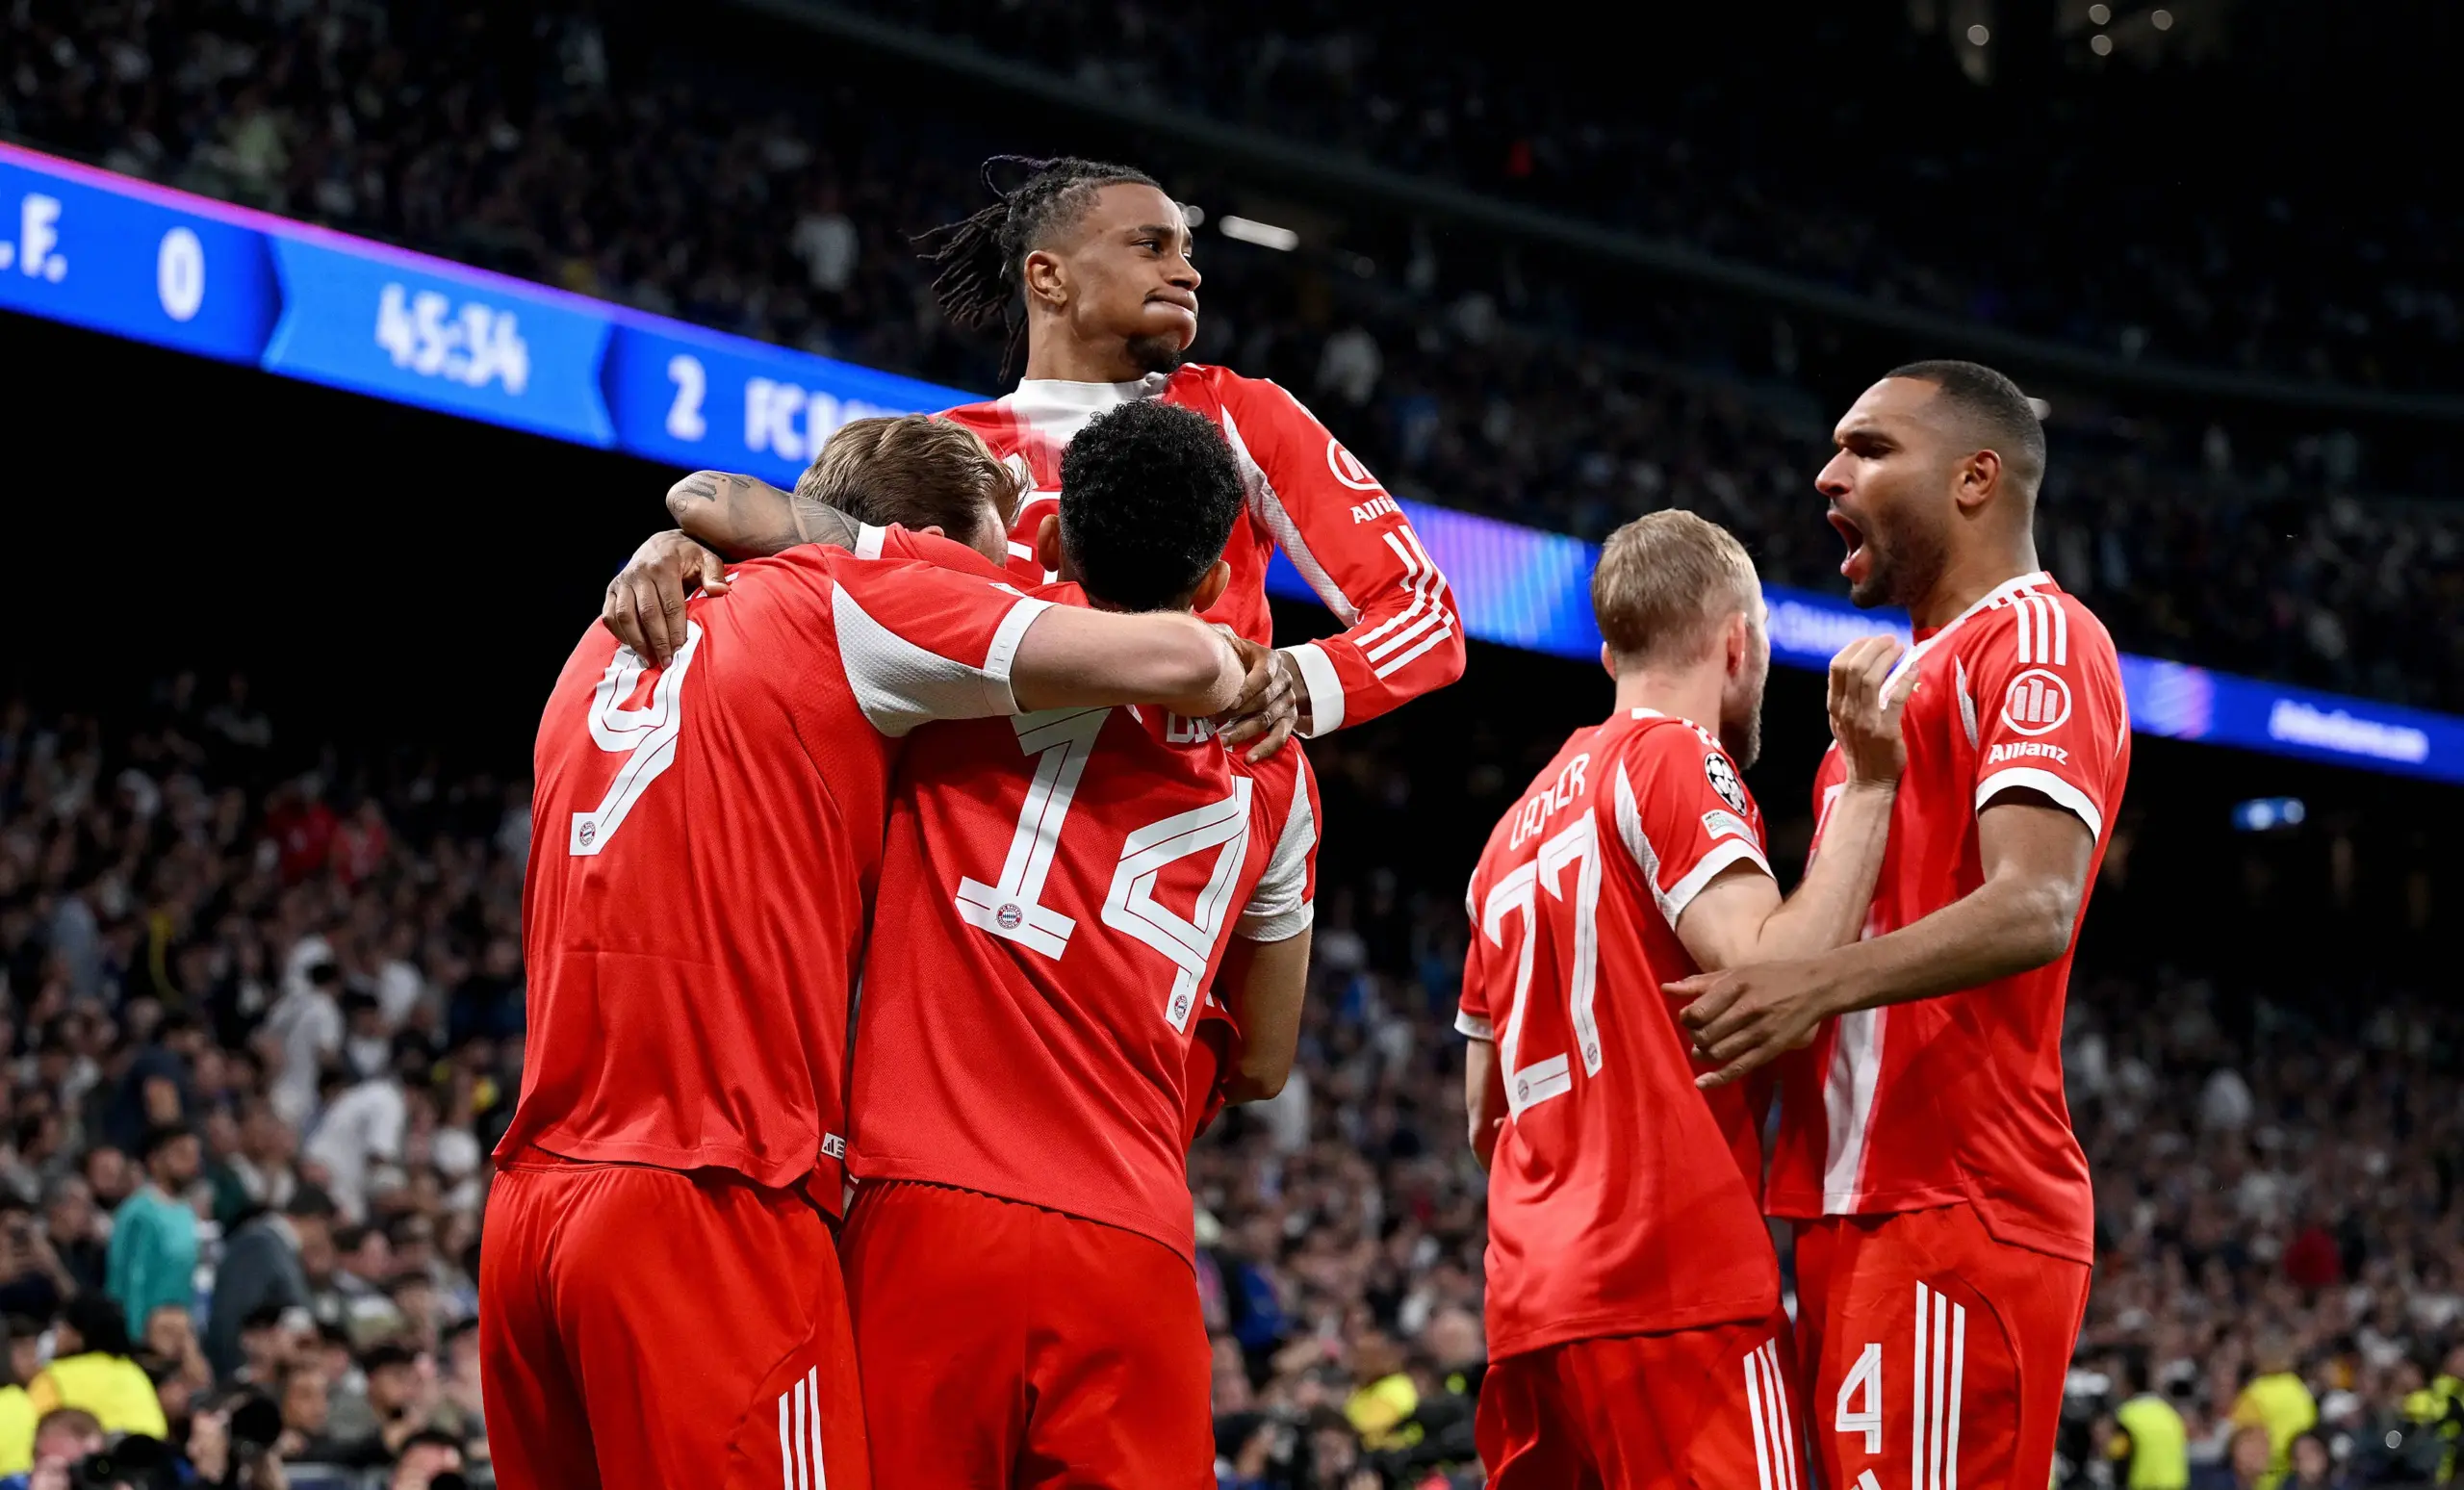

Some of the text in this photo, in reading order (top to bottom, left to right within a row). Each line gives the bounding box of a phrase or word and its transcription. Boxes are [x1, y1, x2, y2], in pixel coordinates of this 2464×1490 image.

[157, 226, 205, 321] 0
[375, 282, 528, 397] 45:34
[665, 353, 706, 442] 2
[1349, 496, 1402, 525] Allia
[569, 619, 703, 856] 9
[1988, 741, 2068, 766] Allianz
[954, 705, 1253, 1036] 14
[1481, 806, 1603, 1127] 27
[1835, 1343, 1882, 1454] 4
